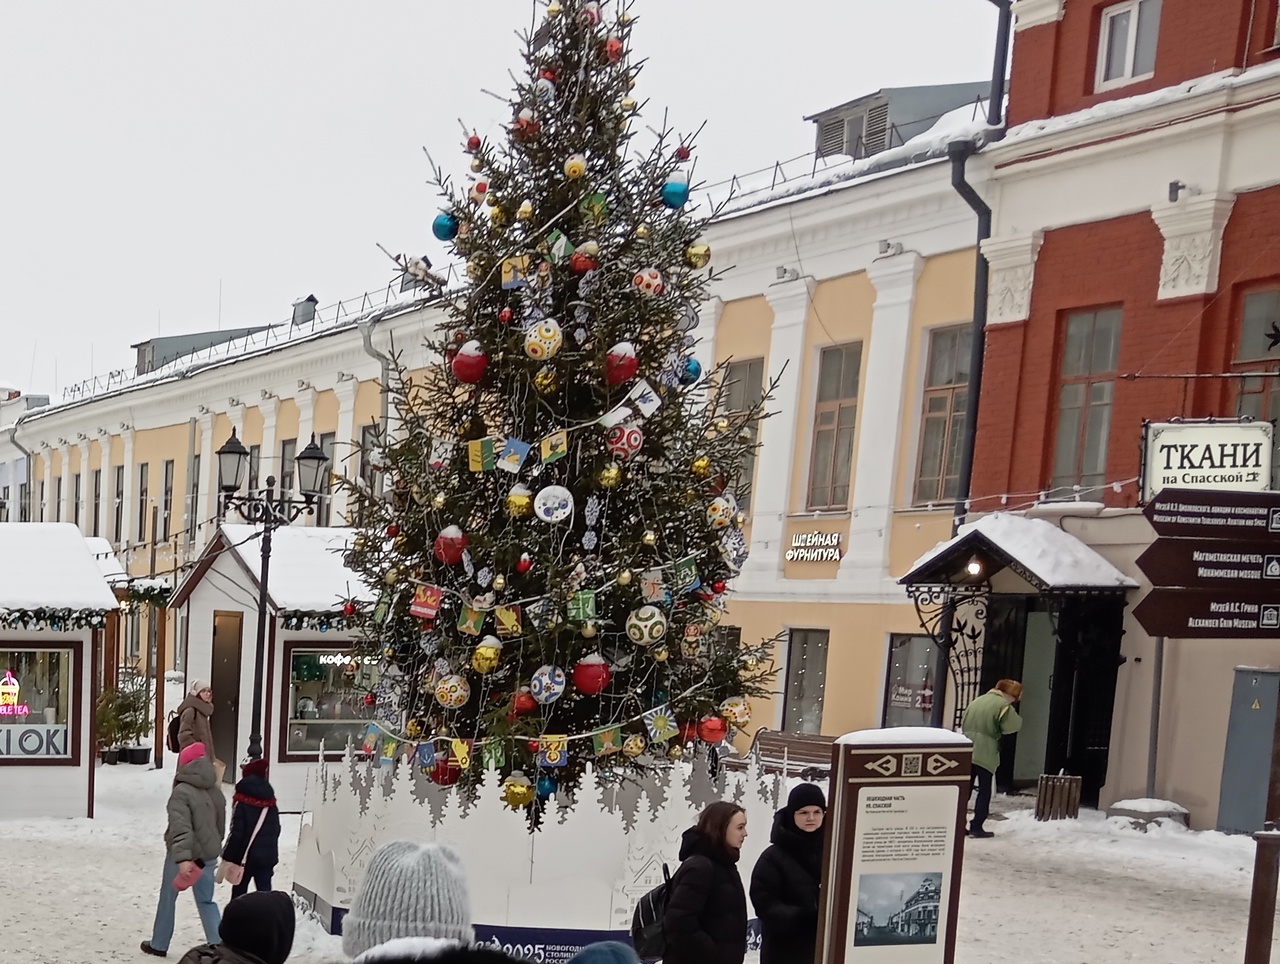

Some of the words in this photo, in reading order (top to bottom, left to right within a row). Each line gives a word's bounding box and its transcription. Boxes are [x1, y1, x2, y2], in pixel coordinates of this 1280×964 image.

[1160, 443, 1262, 469] ТКАНИ
[1162, 475, 1177, 485] на
[1182, 472, 1243, 484] Спасской
[792, 530, 839, 547] ШВЕЙНАЯ
[785, 548, 841, 562] ФУРНИТУРА
[319, 652, 351, 667] кофе
[915, 695, 922, 708] 2
[14, 705, 29, 715] TEA
[18, 729, 68, 755] OKI
